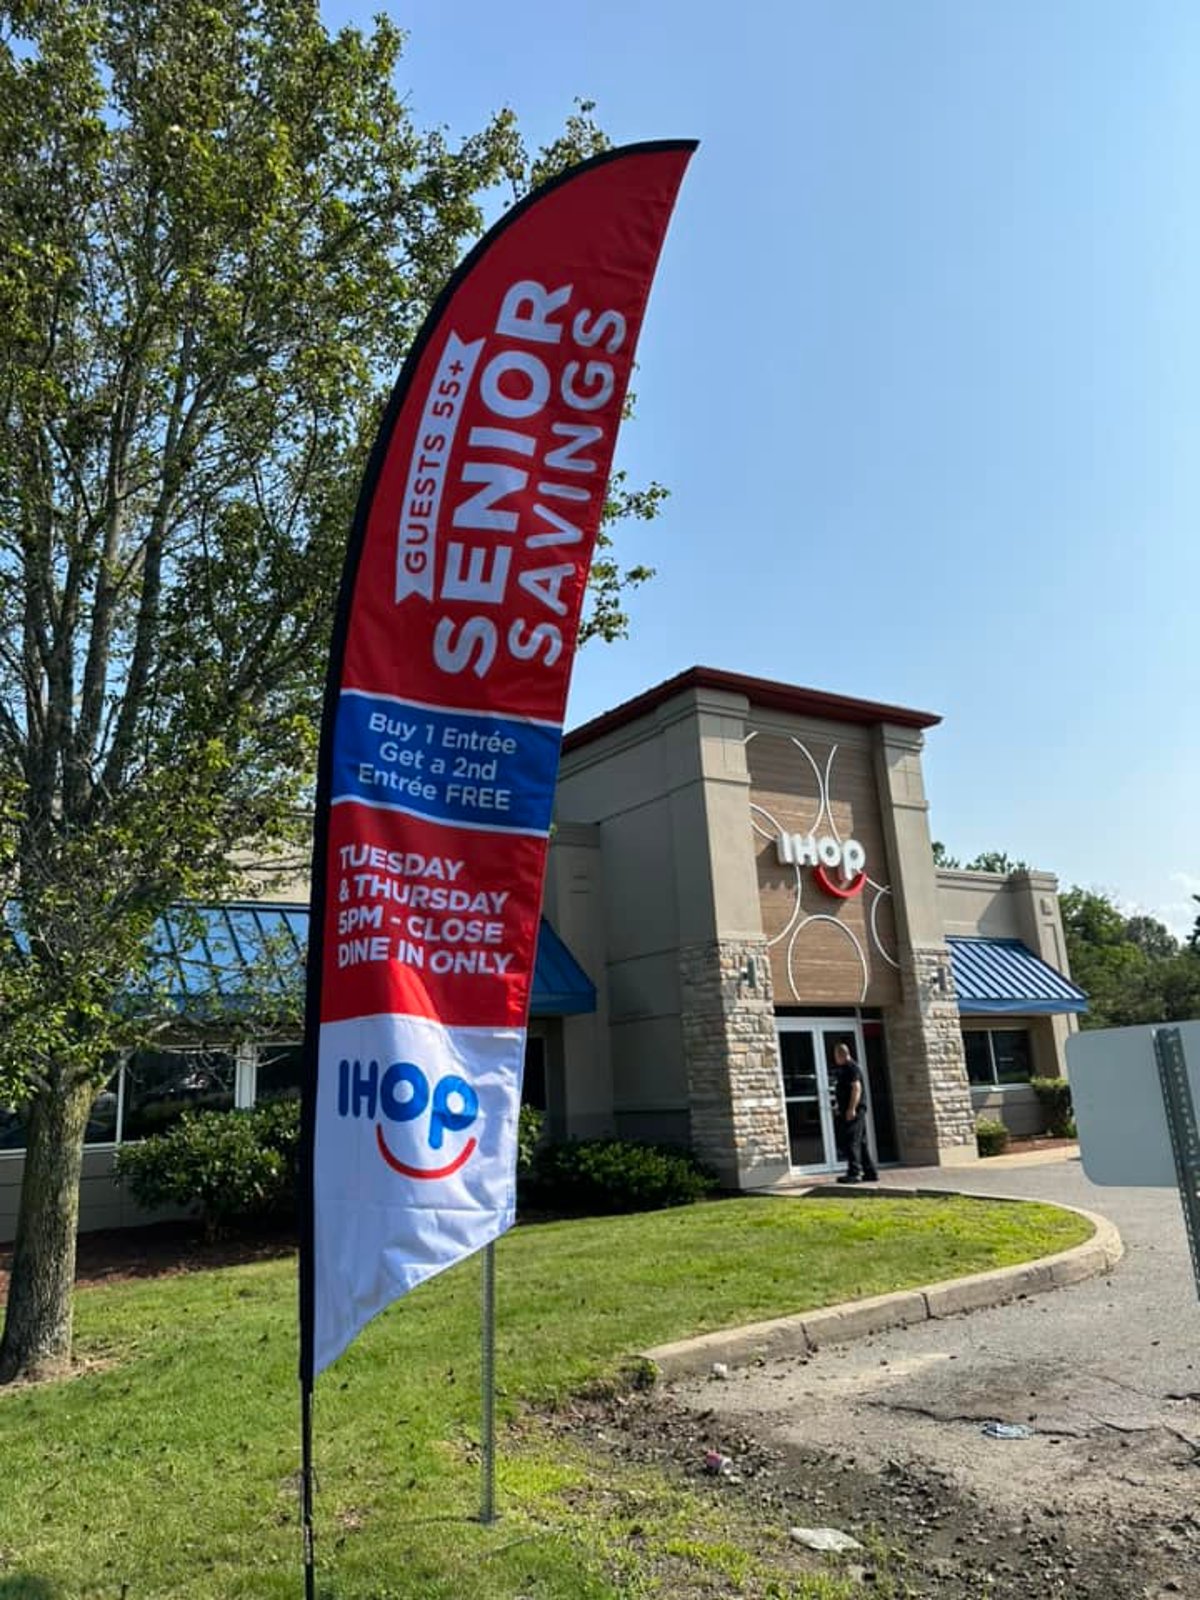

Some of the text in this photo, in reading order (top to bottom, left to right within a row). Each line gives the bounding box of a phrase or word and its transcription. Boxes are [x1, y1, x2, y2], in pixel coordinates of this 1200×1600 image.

[405, 359, 464, 574] GUESTS 55+
[433, 280, 573, 678] SENIOR
[507, 308, 627, 667] SAVINGS
[369, 712, 517, 754] Buy 1 Entrée
[380, 742, 497, 781] Get a 2nd
[359, 763, 511, 811] Entrée FREE
[340, 844, 464, 880] TUESDAY
[339, 875, 510, 914] & THURSDAY
[338, 905, 504, 943] 5PM - CLOSE
[338, 937, 514, 975] DINE IN ONLY
